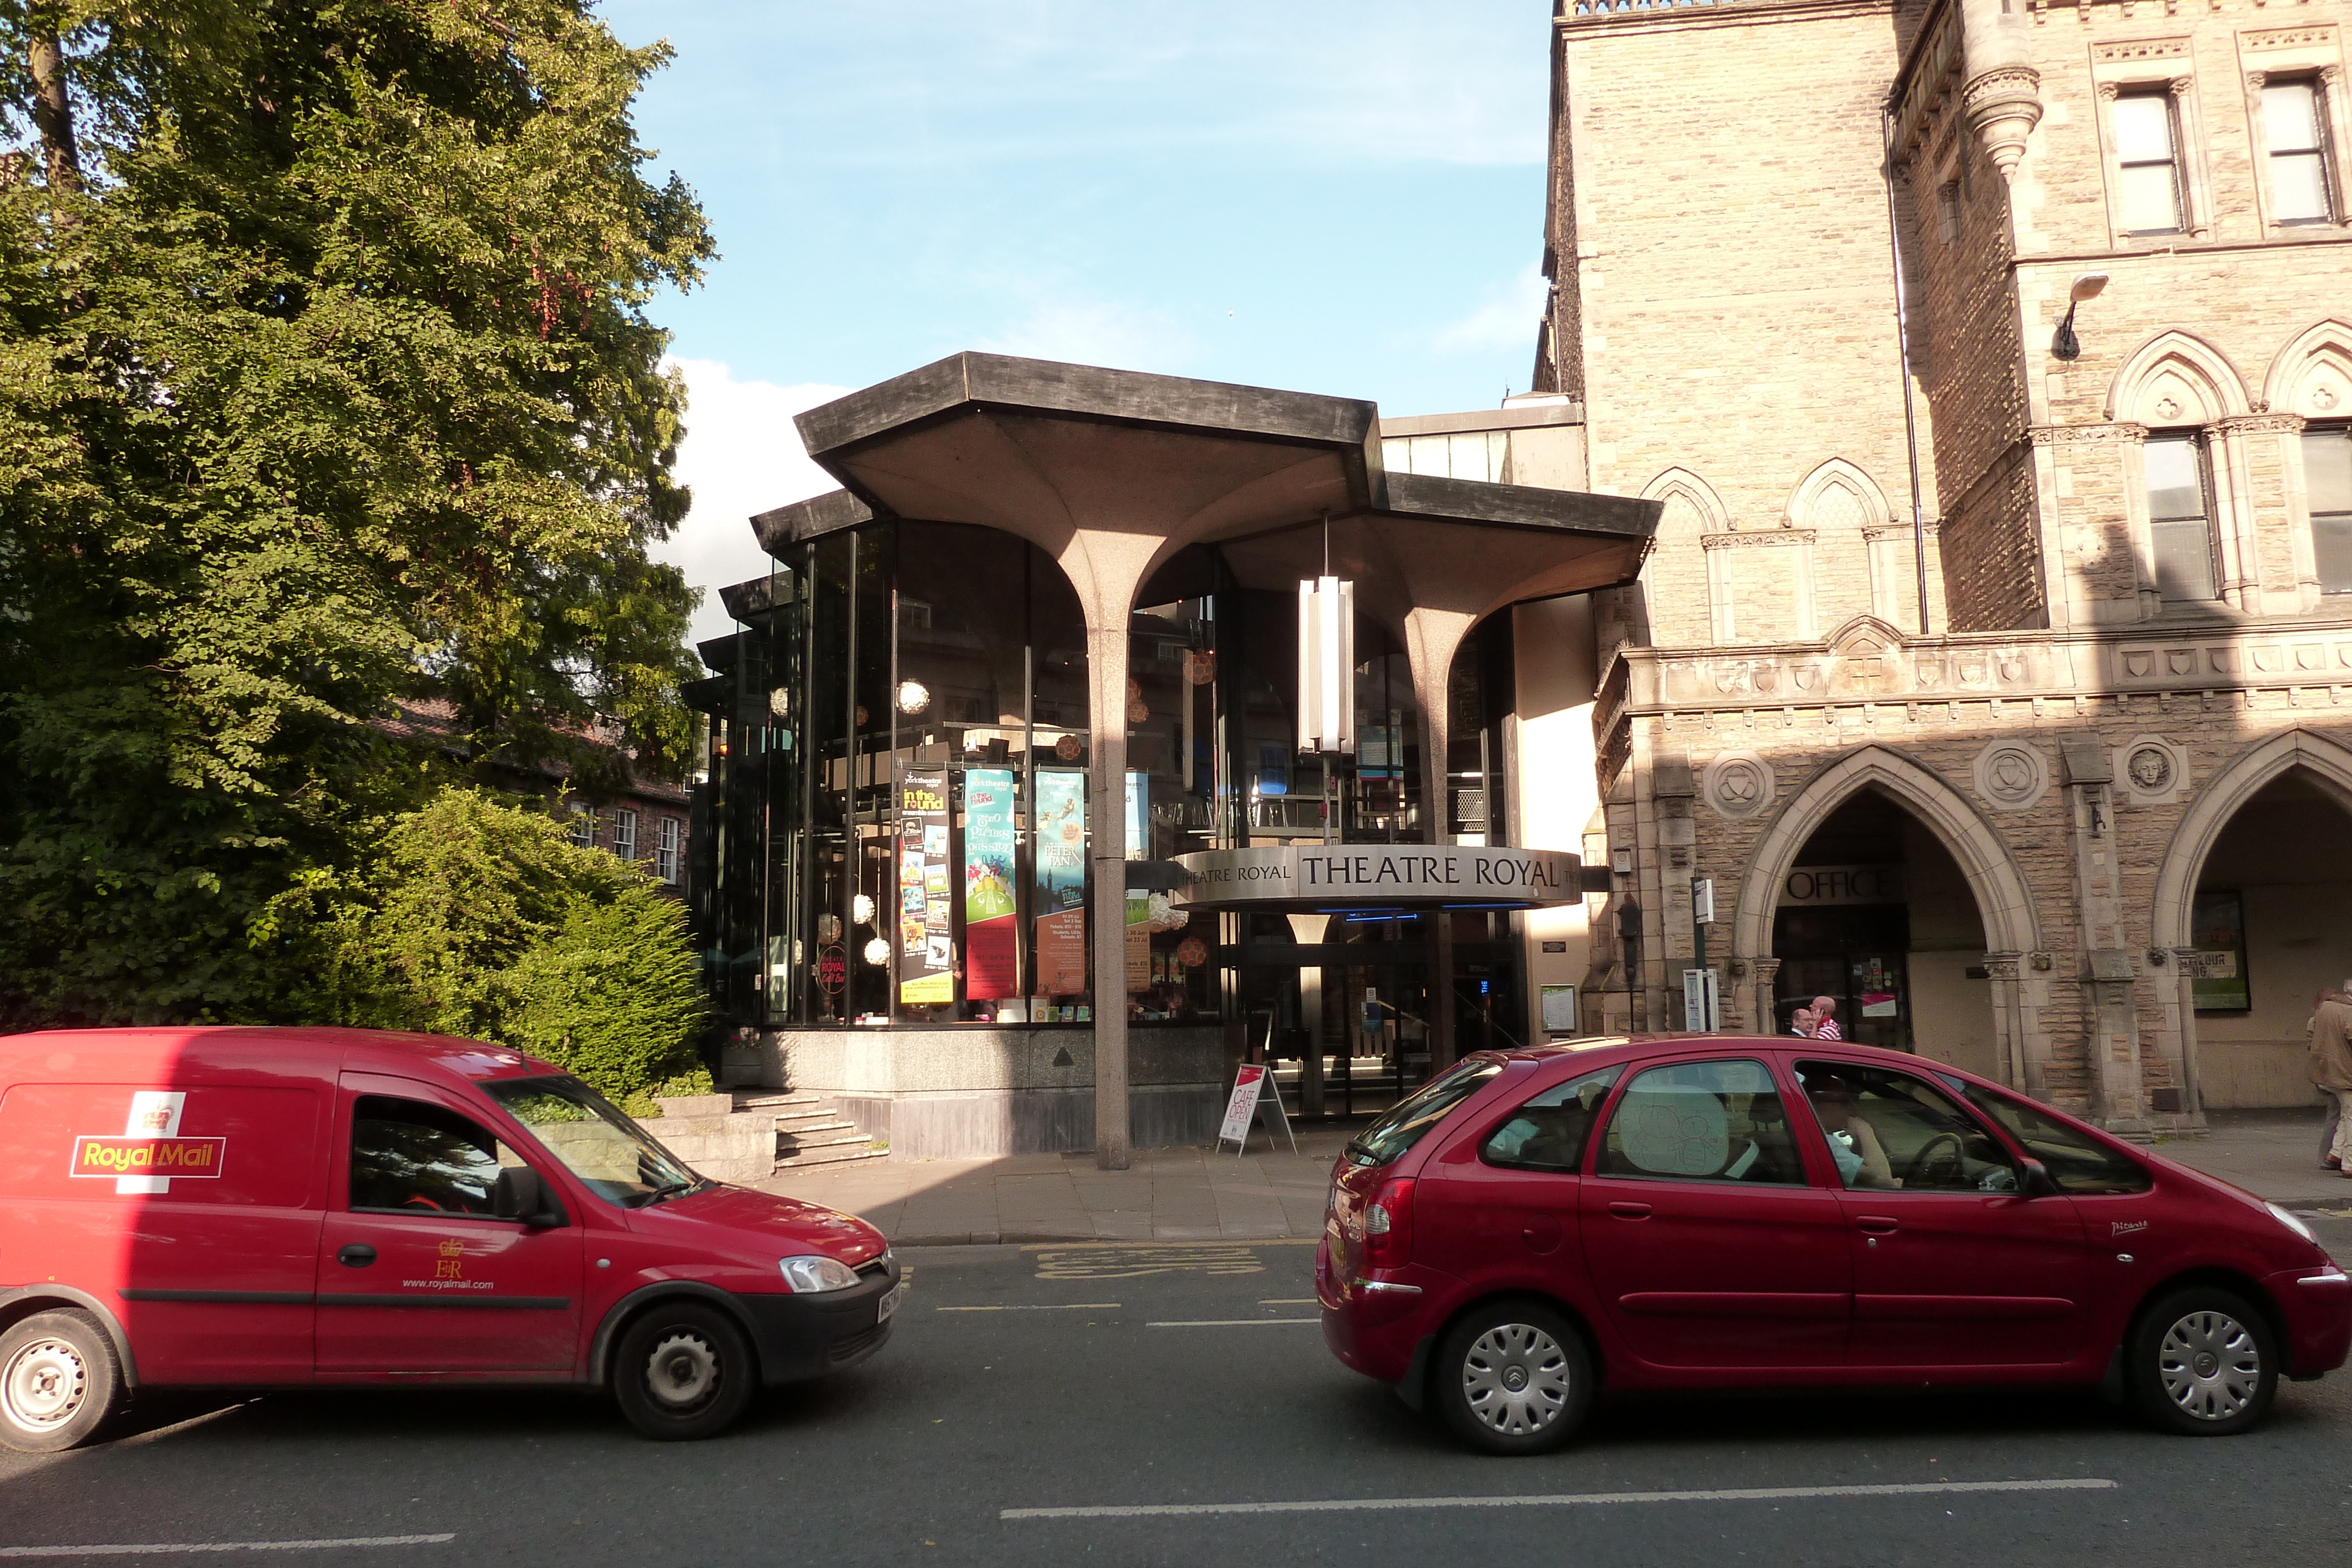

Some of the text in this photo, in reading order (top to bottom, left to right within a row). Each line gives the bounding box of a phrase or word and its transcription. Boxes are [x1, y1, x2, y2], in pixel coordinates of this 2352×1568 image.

[970, 780, 1010, 788] yorktheatre
[904, 788, 936, 800] in the
[971, 794, 992, 805] round
[904, 796, 944, 810] round
[1045, 846, 1075, 856] PETER
[1050, 856, 1071, 867] PAN
[1181, 866, 1291, 885] THEATRE ROYAL
[1302, 857, 1559, 888] THEATRE ROYAL
[1786, 870, 1893, 900] OFFICE
[821, 962, 845, 972] ROYAL
[1229, 1105, 1250, 1119] OPEN
[83, 1143, 213, 1171] Royal Mail
[403, 1279, 494, 1290] www.royalmail.com
